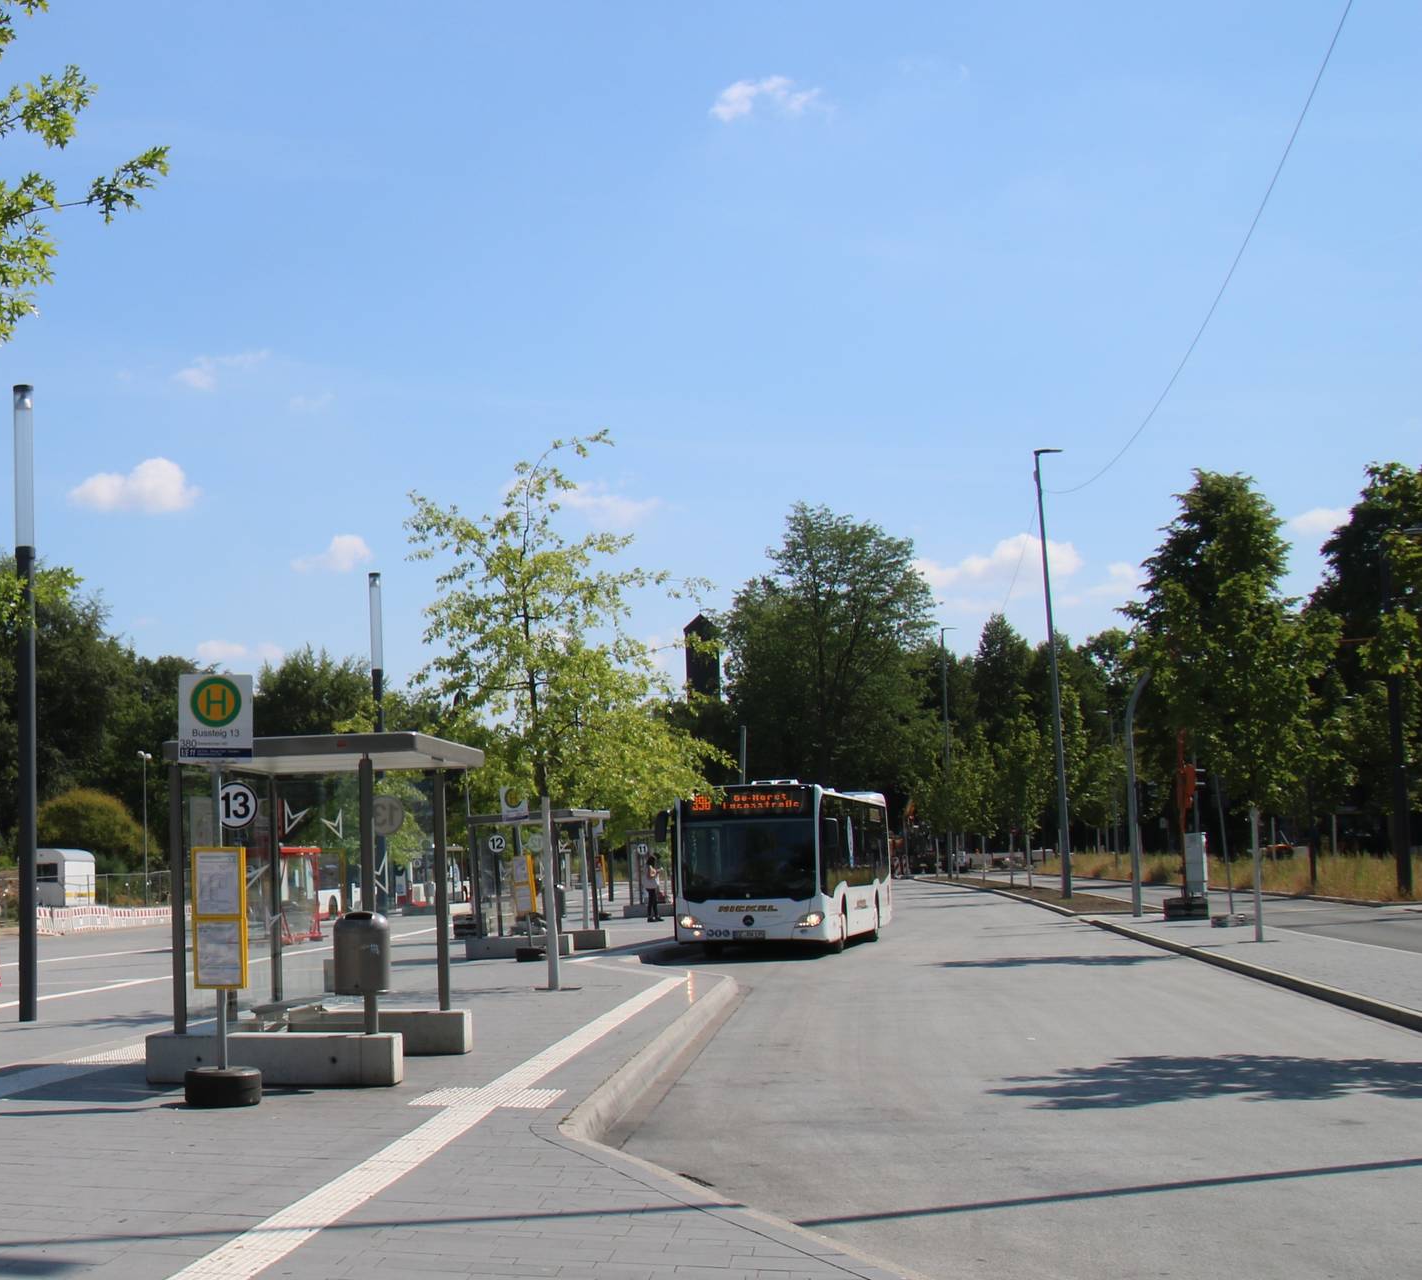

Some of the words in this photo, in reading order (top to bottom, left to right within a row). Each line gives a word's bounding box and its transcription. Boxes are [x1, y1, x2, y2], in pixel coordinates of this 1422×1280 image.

[206, 688, 226, 717] H
[192, 728, 227, 738] Bussteig
[230, 728, 240, 737] 13
[221, 791, 250, 819] 13
[490, 837, 504, 850] 12
[639, 845, 647, 853] 11
